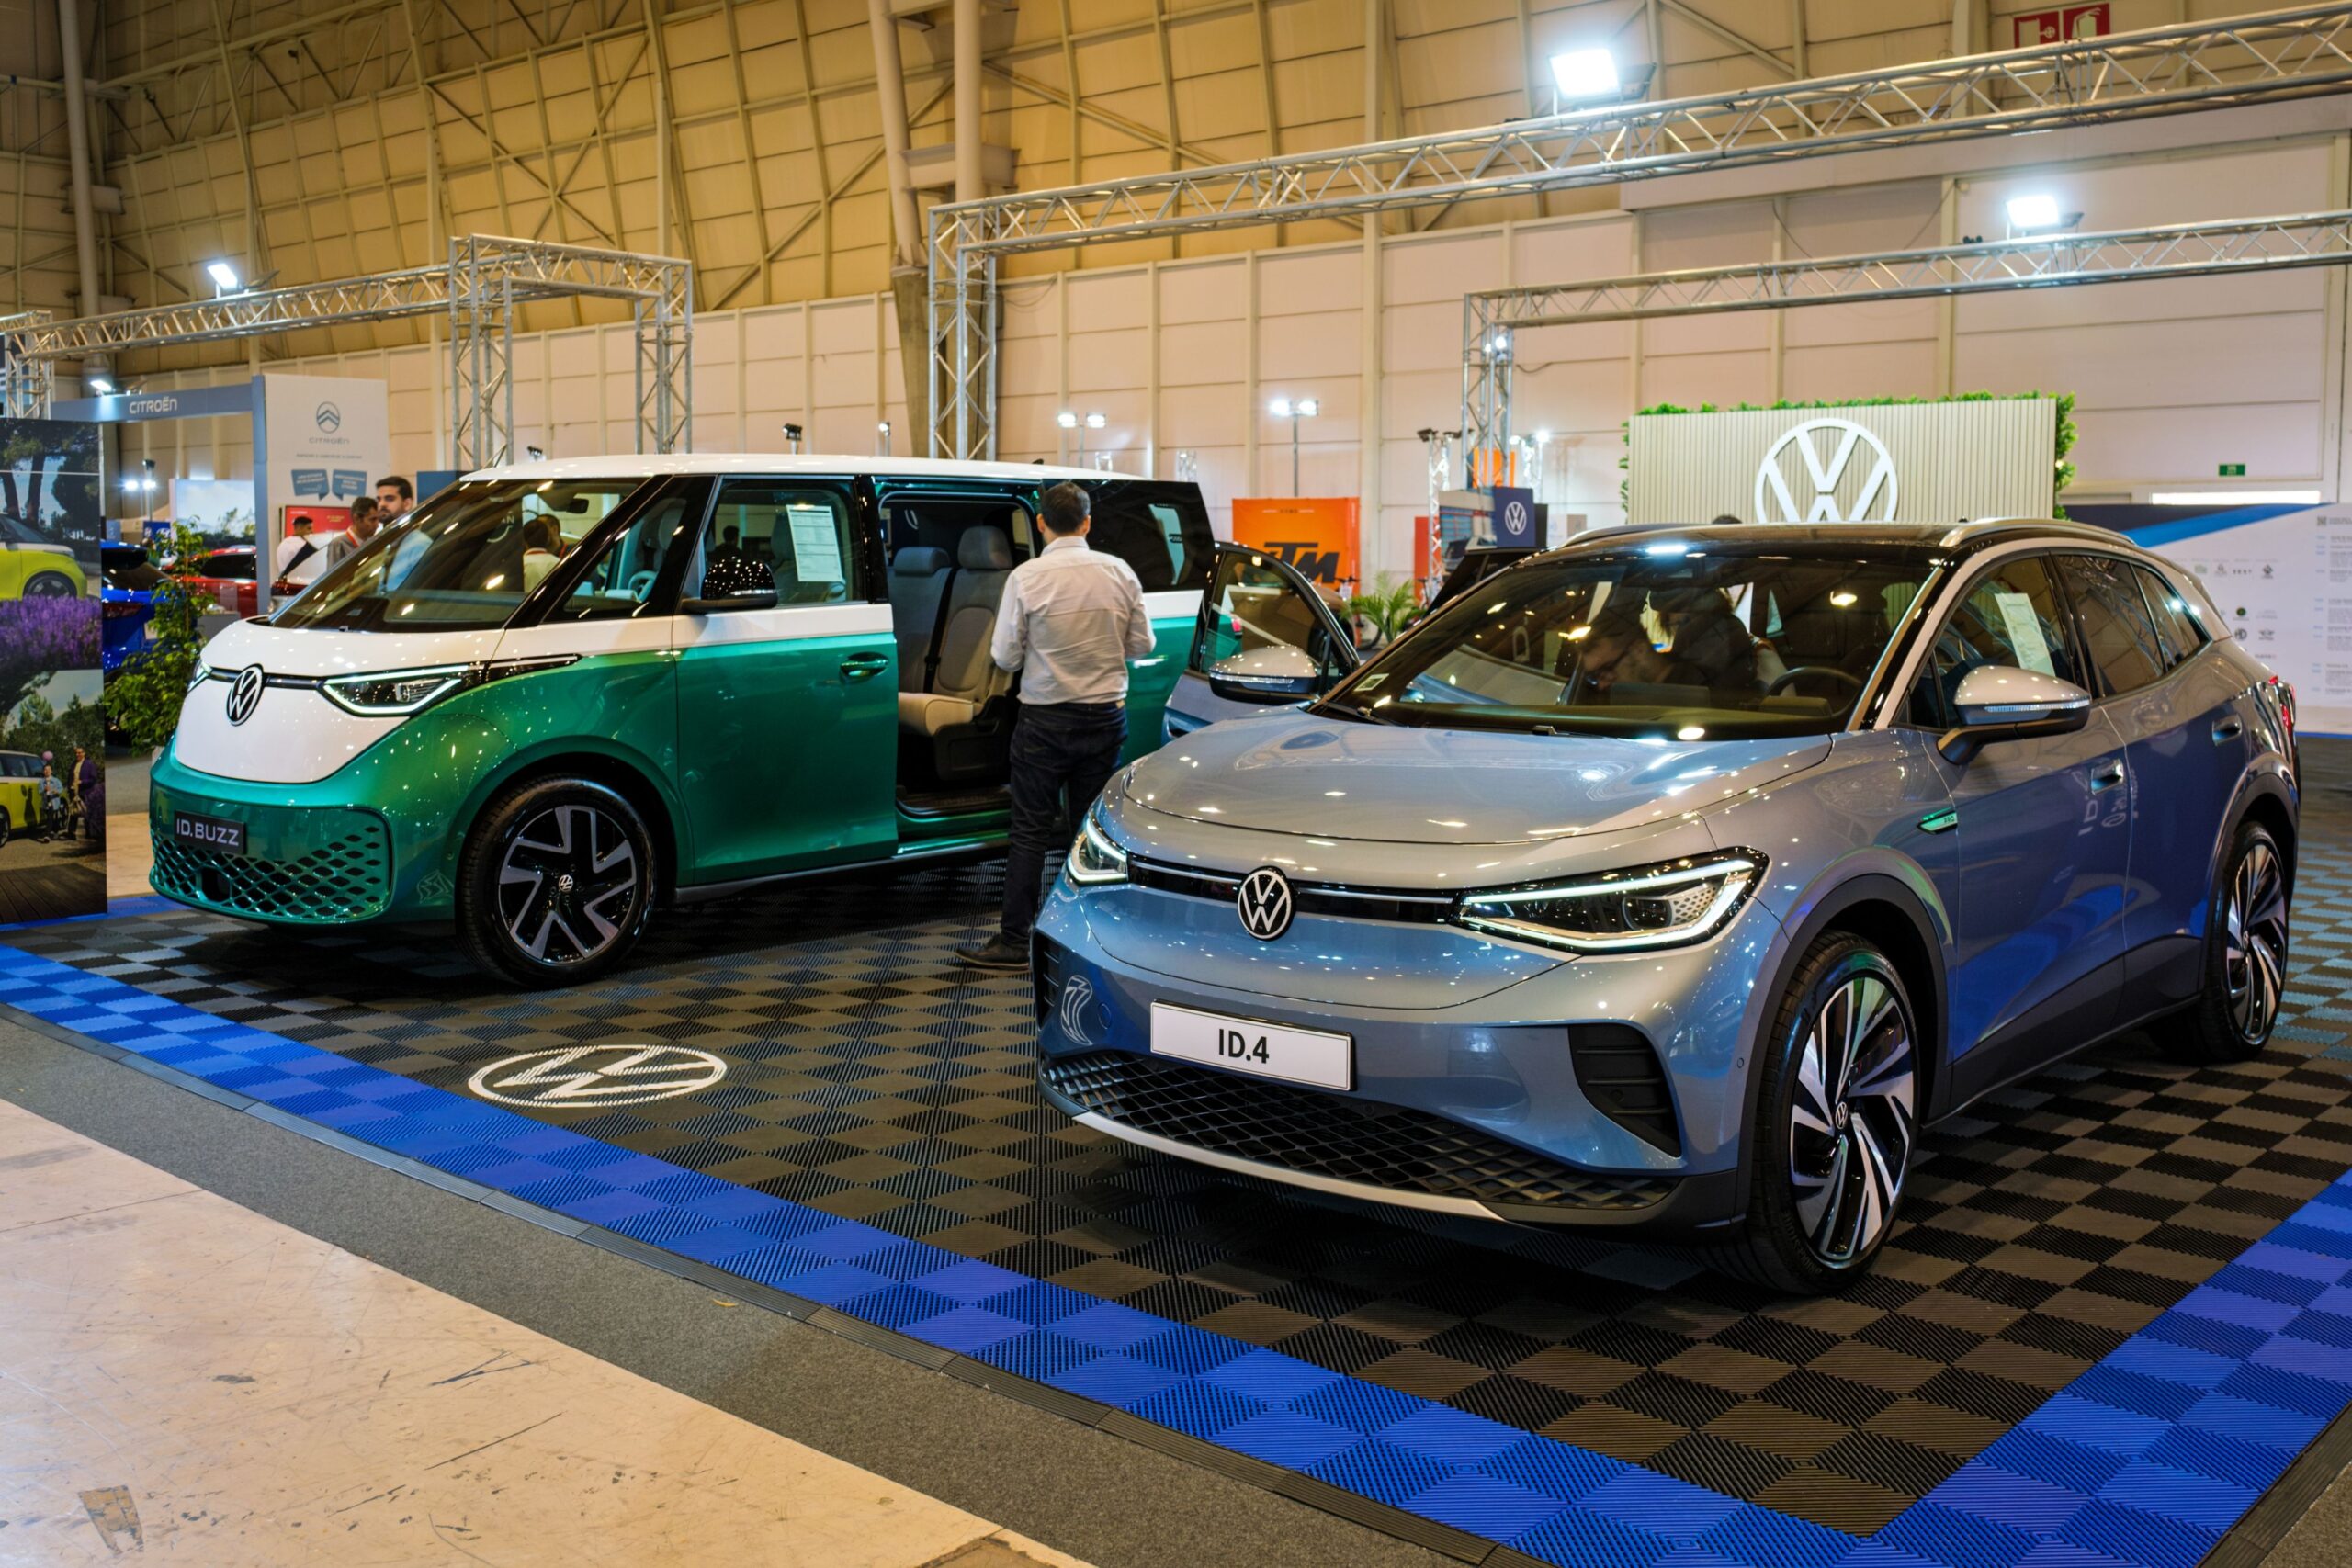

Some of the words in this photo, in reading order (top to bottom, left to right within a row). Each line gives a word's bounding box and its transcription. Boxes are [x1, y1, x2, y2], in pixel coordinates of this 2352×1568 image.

[129, 395, 177, 414] CITROËN
[1263, 542, 1340, 583] TM
[176, 818, 239, 846] ID.BUZZ
[1218, 1028, 1270, 1065] ID.4
